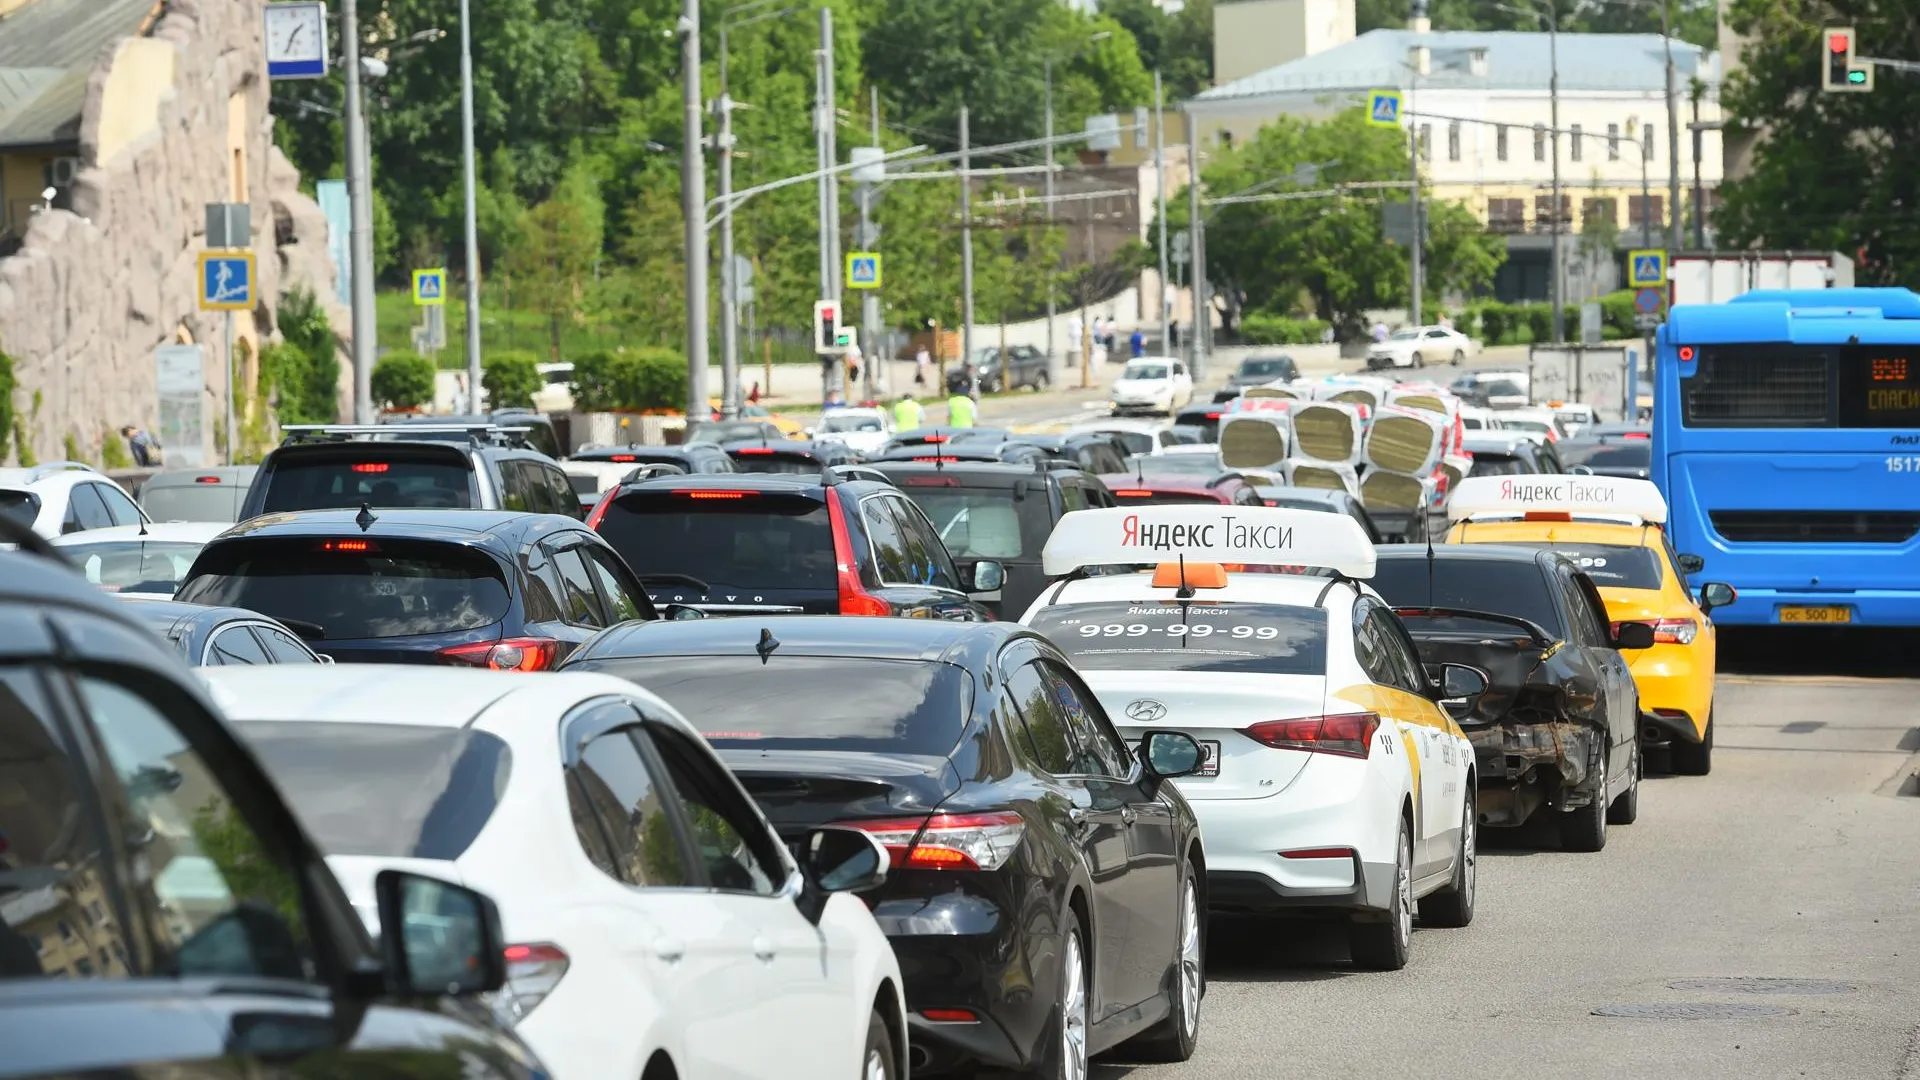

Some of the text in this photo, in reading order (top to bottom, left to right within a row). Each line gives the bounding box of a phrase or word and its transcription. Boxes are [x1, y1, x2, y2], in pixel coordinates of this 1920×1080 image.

[1501, 480, 1614, 502] Яндекс Такси
[1122, 515, 1292, 551] Яндекс Такси
[1127, 606, 1229, 615] Яндекс Такси
[1805, 609, 1828, 620] 500
[1080, 623, 1279, 640] 999-99-99
